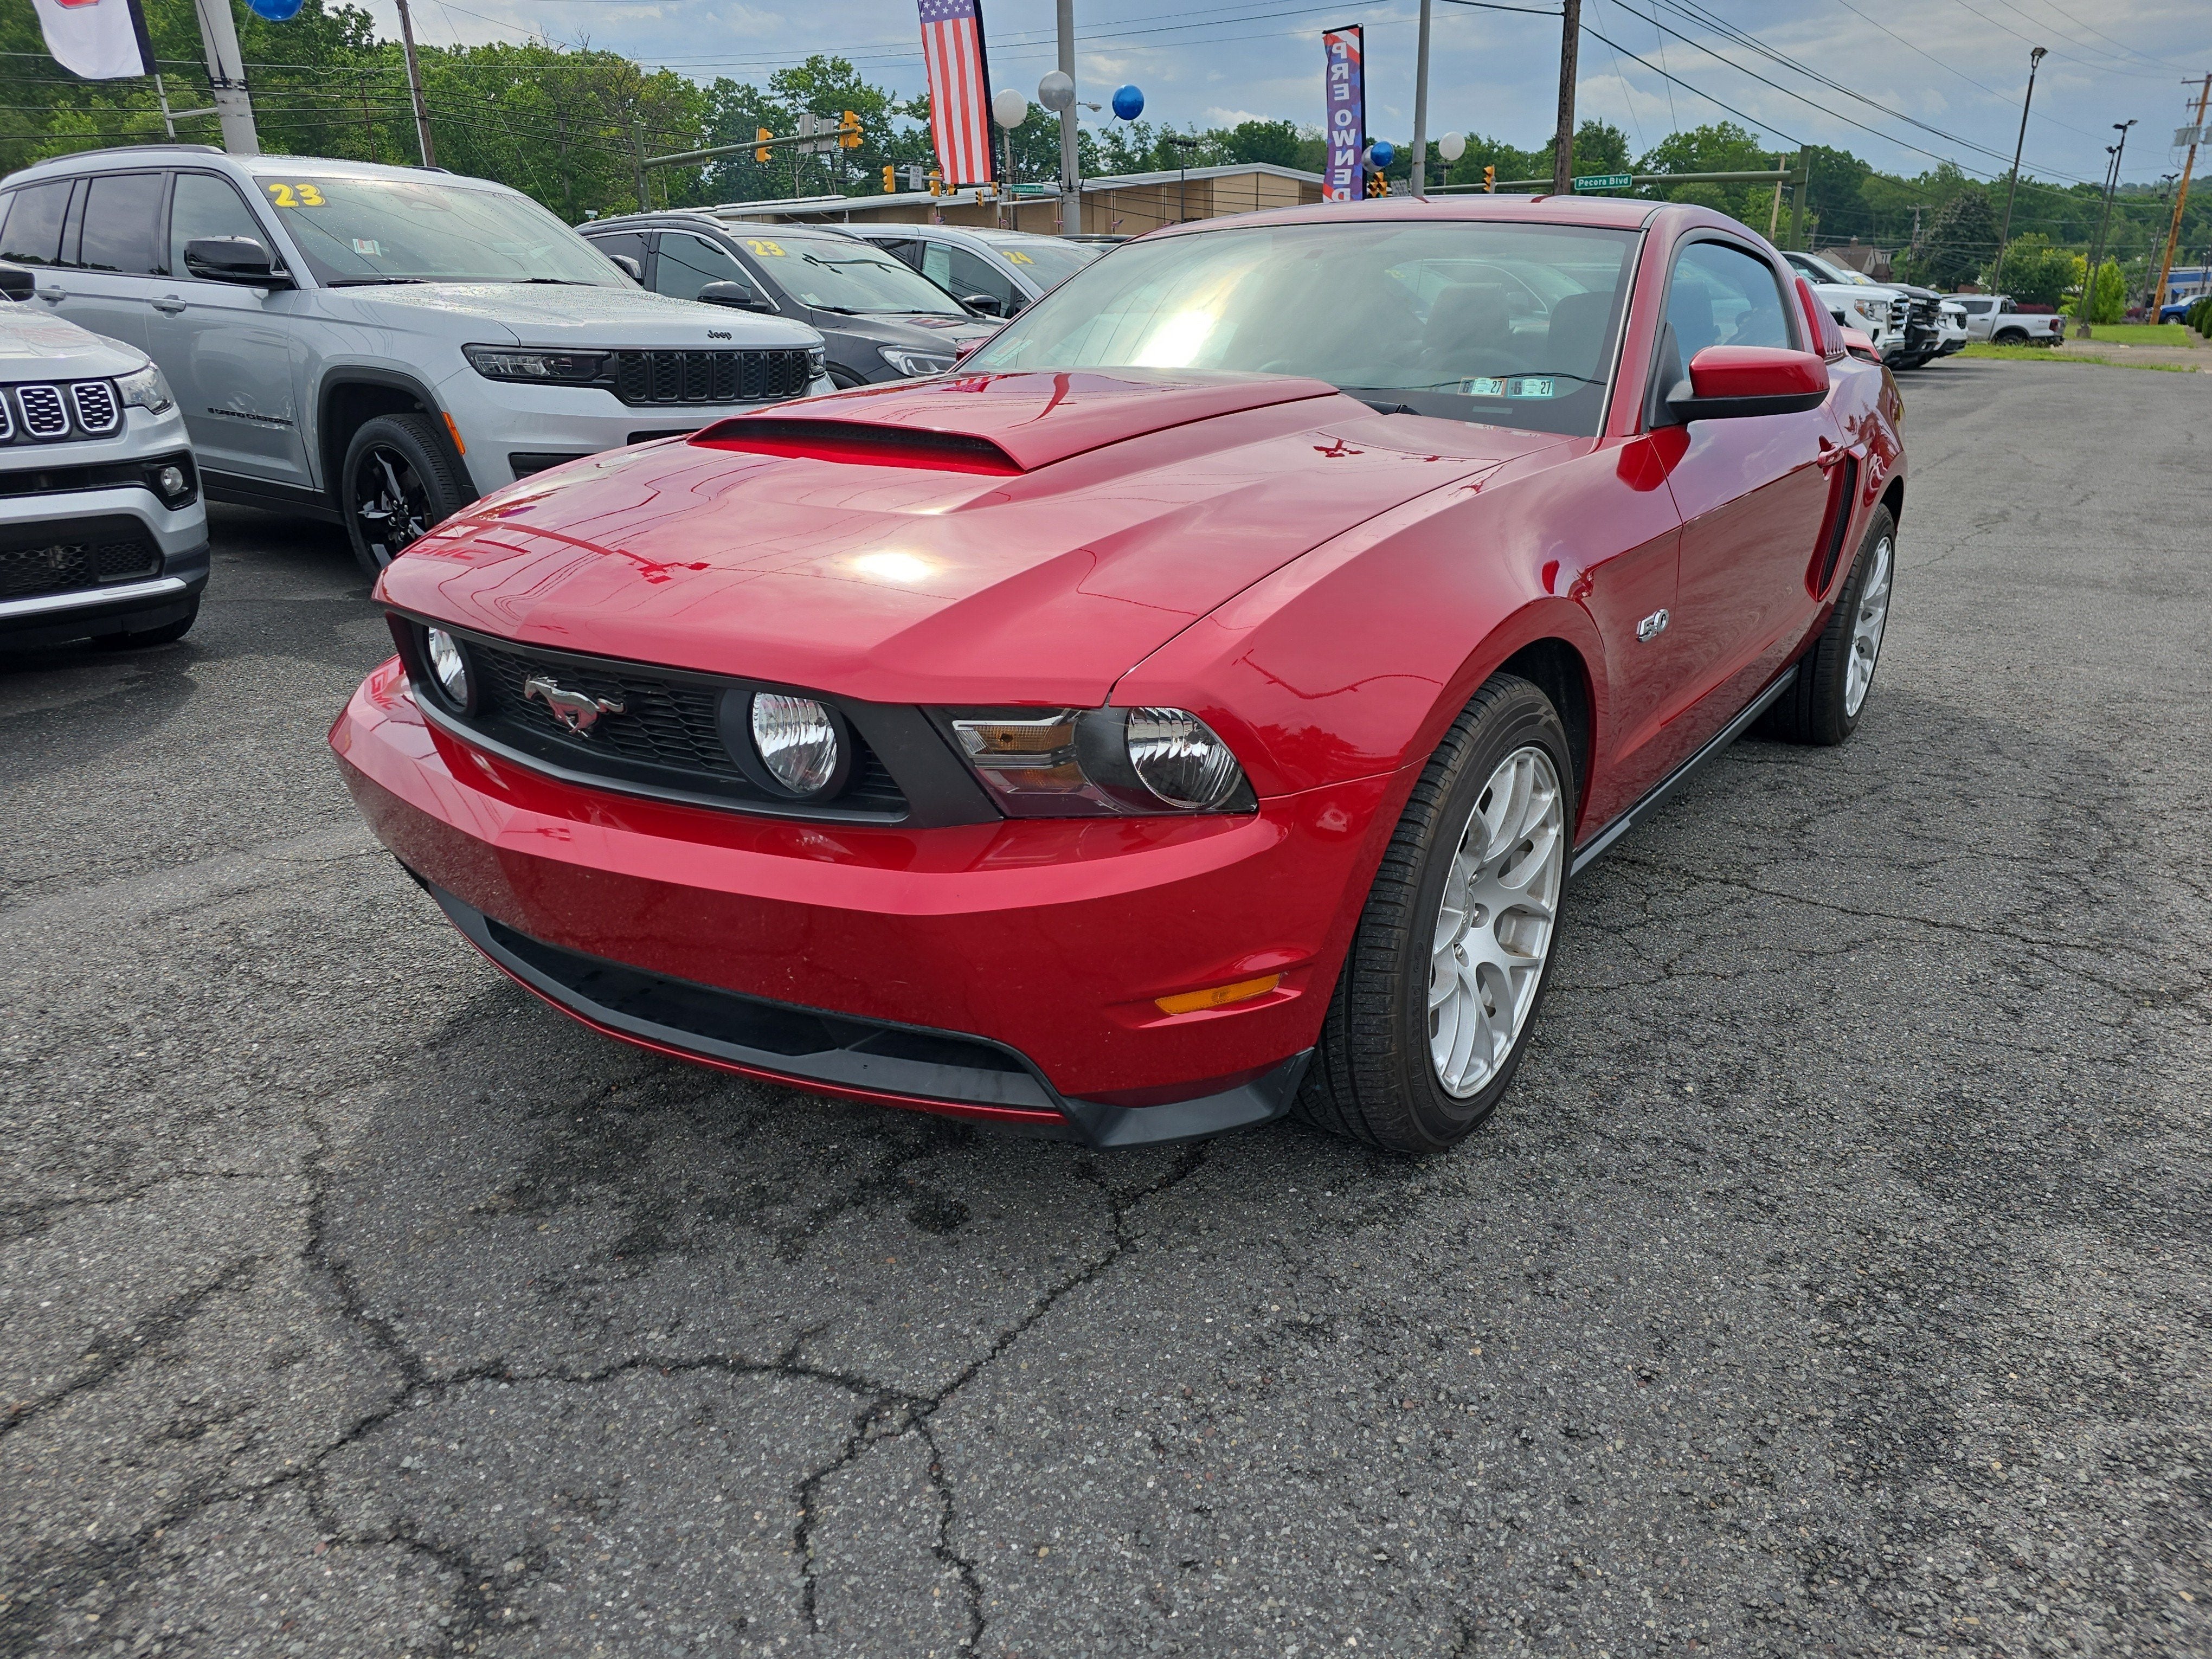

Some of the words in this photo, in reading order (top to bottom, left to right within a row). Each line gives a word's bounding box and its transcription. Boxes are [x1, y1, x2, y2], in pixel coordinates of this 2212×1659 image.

[1609, 177, 1628, 185] Blvd
[269, 184, 325, 207] 23
[747, 240, 786, 256] 23
[1002, 251, 1036, 264] 24
[707, 330, 732, 340] Jeep
[1490, 381, 1502, 394] 27
[1540, 381, 1551, 395] 27
